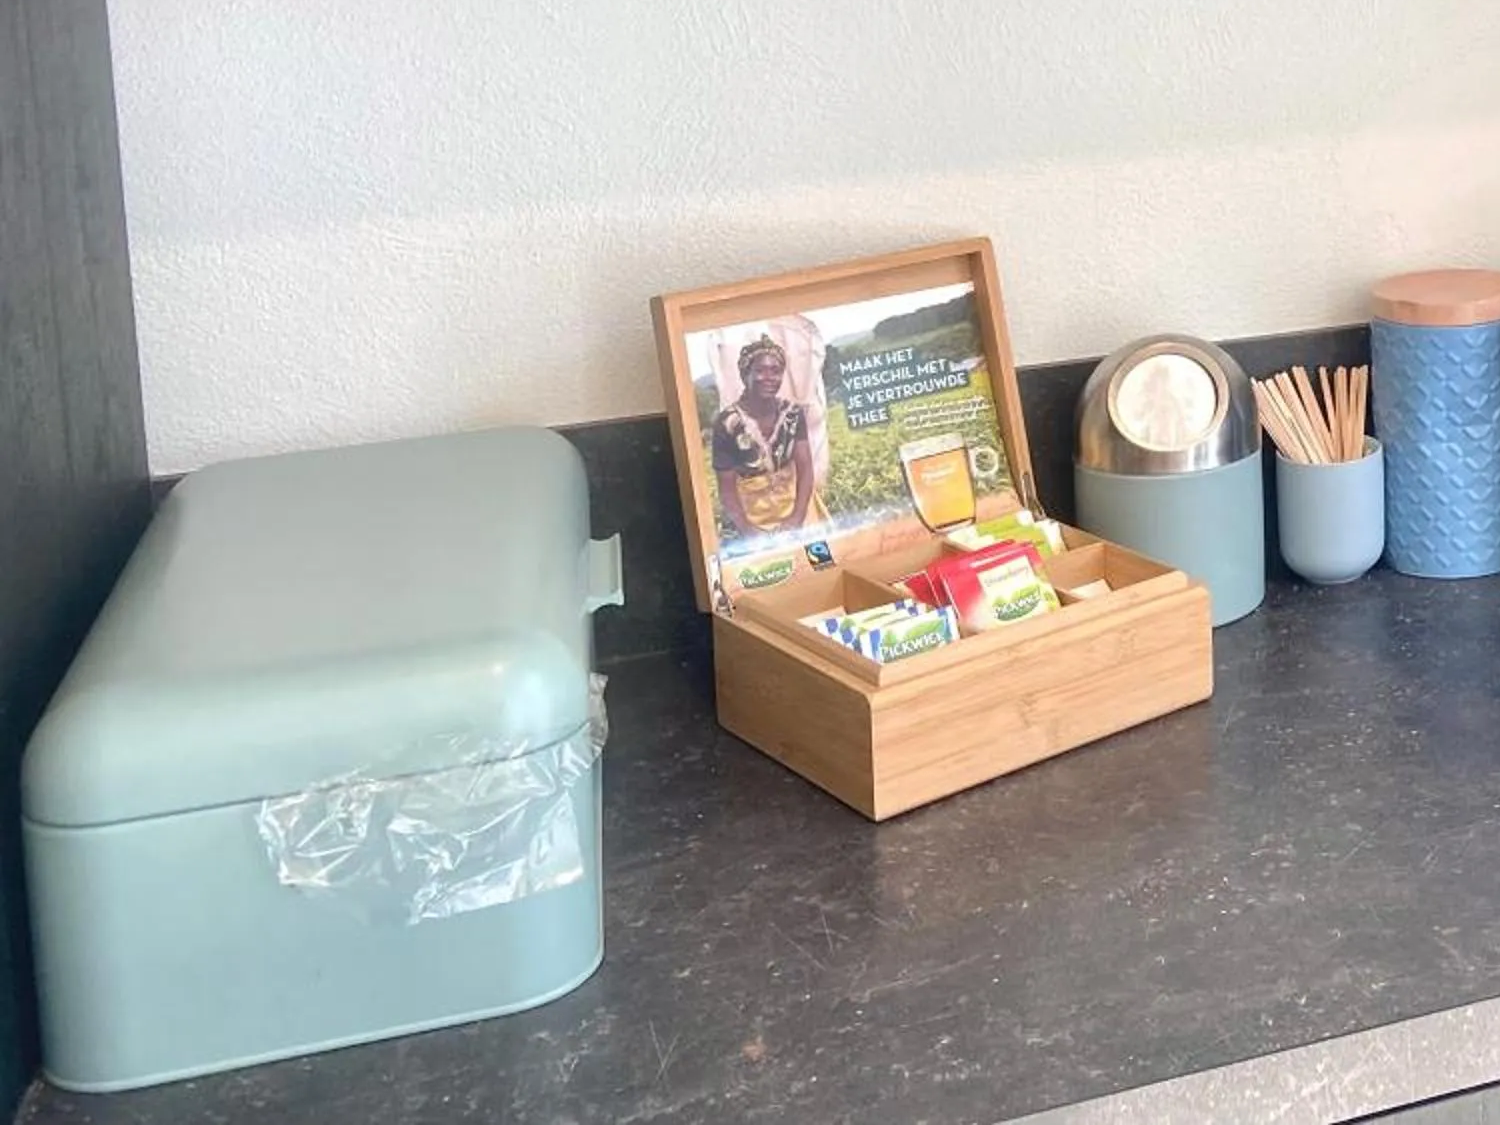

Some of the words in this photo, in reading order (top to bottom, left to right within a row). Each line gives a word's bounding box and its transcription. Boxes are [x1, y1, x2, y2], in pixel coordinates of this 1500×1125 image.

[839, 353, 883, 375] MAAK
[886, 346, 914, 365] HET
[842, 365, 915, 392] VERSCHIL
[917, 358, 947, 376] MET
[847, 394, 863, 410] JE
[866, 371, 969, 404] VERTROUWDE
[848, 407, 889, 428] THEE
[880, 630, 946, 661] PICKWICK
